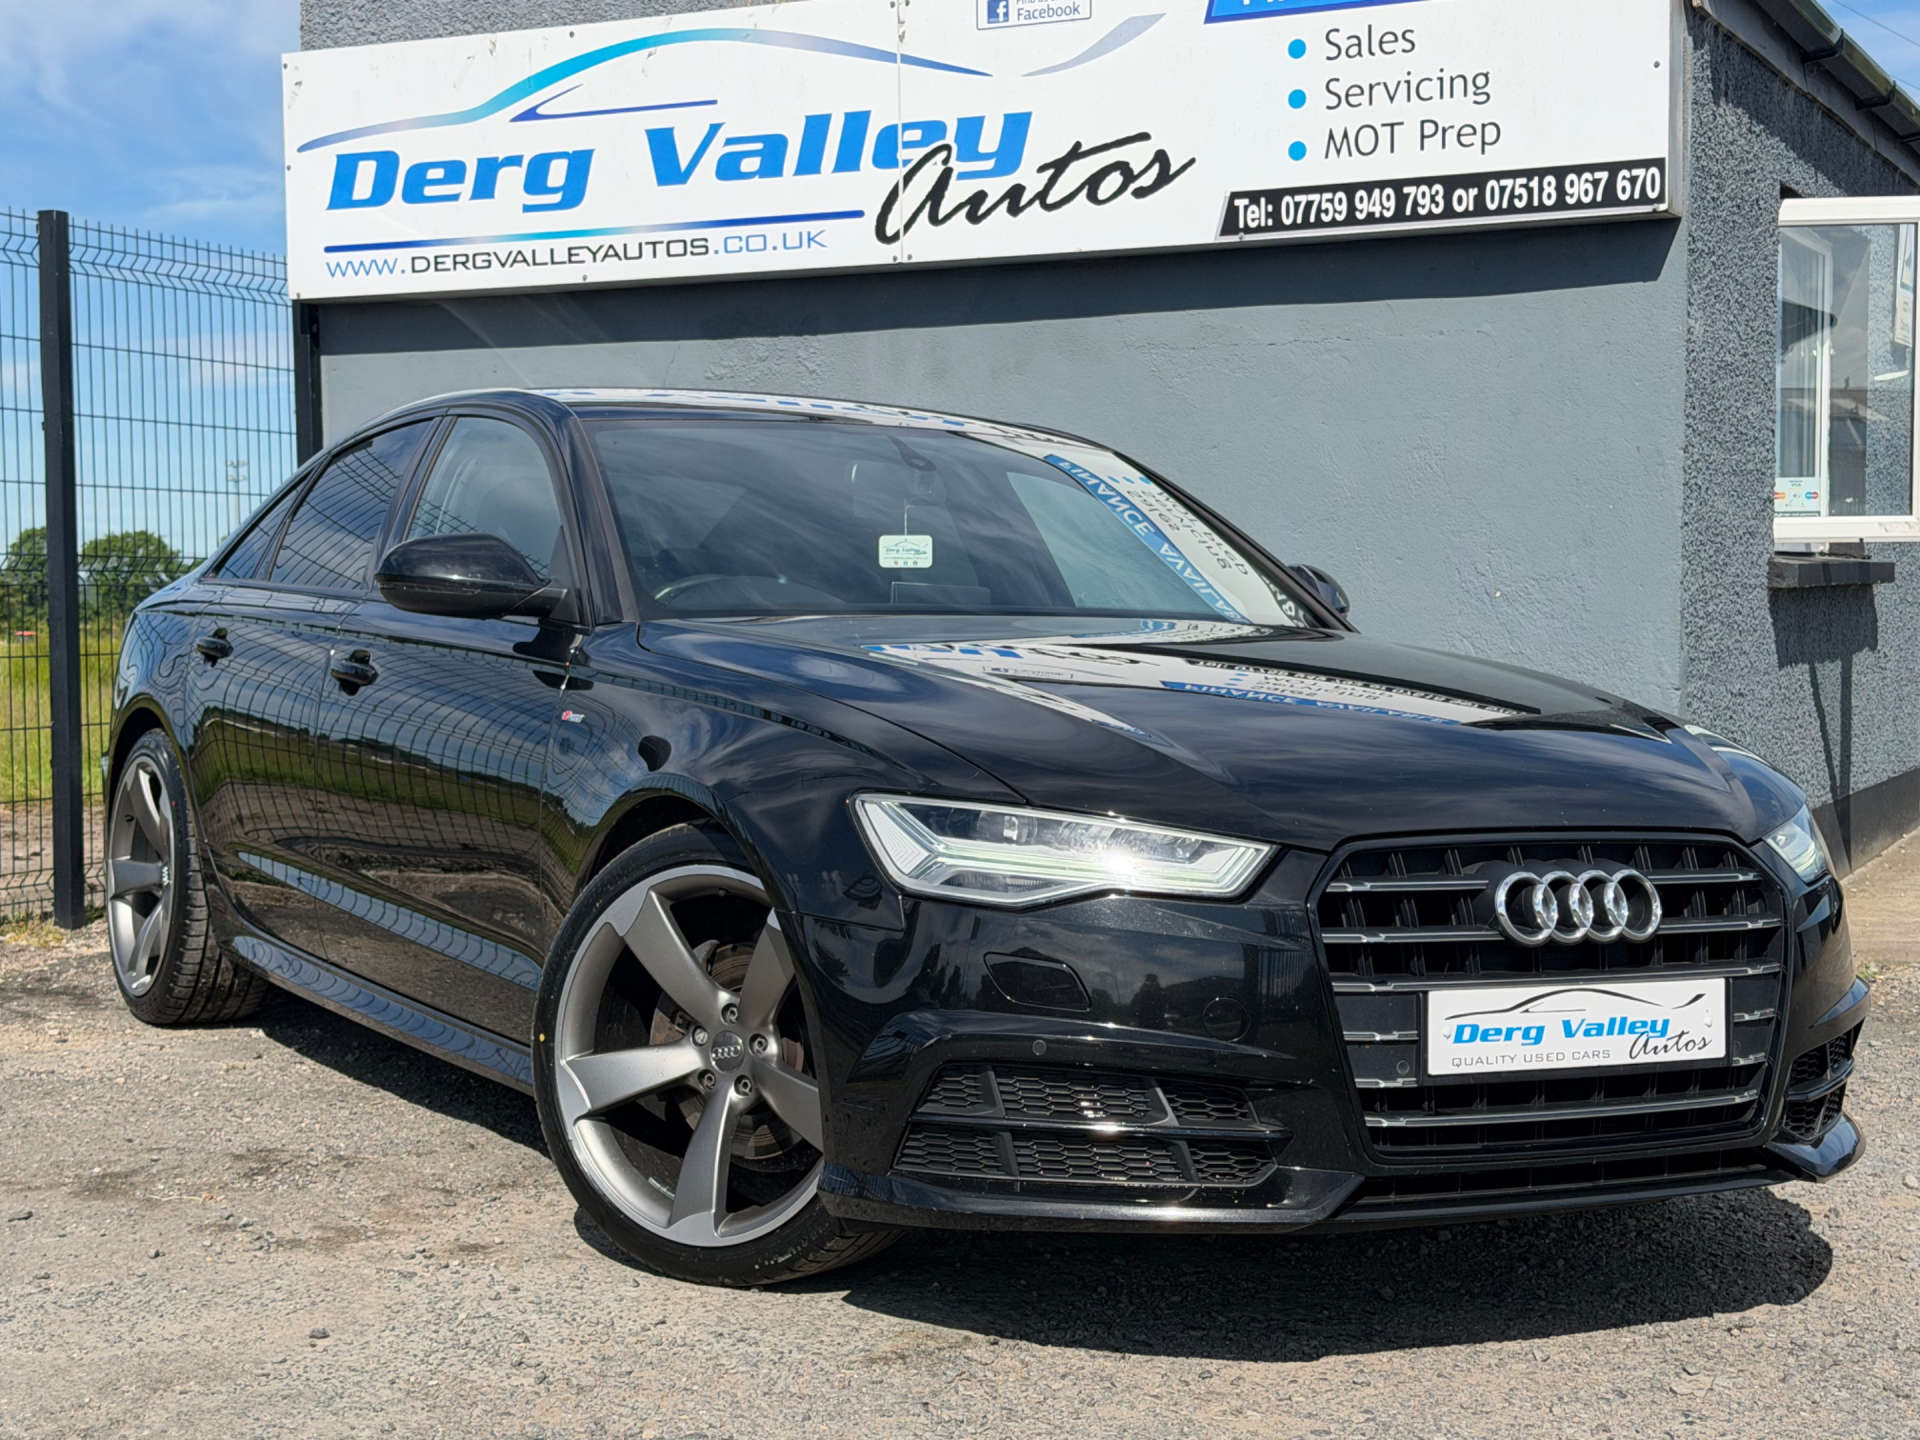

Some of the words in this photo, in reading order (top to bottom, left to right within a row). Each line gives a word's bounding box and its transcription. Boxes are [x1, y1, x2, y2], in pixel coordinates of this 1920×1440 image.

[1017, 1, 1081, 21] Facebook
[1325, 24, 1416, 61] Sales
[1325, 68, 1491, 111] Servicing
[1325, 121, 1405, 159] MOT
[1420, 118, 1502, 155] Prep
[326, 148, 596, 213] Derg
[644, 109, 1033, 188] Valley
[874, 131, 1197, 245] Autos
[1234, 198, 1273, 229] Tel:
[1281, 190, 1347, 227] 07759
[1355, 187, 1396, 219] 949
[1403, 184, 1444, 216] 793
[1453, 185, 1478, 213] or
[1485, 174, 1557, 212] 07518
[1564, 171, 1608, 205] 967
[1616, 166, 1661, 200] 670
[1453, 1024, 1545, 1046] Derg
[1561, 1016, 1670, 1039] Valley
[1629, 1029, 1713, 1060] Autos
[1451, 1054, 1518, 1068] QUALITY
[1523, 1051, 1566, 1063] USED
[1572, 1049, 1611, 1061] CARS
